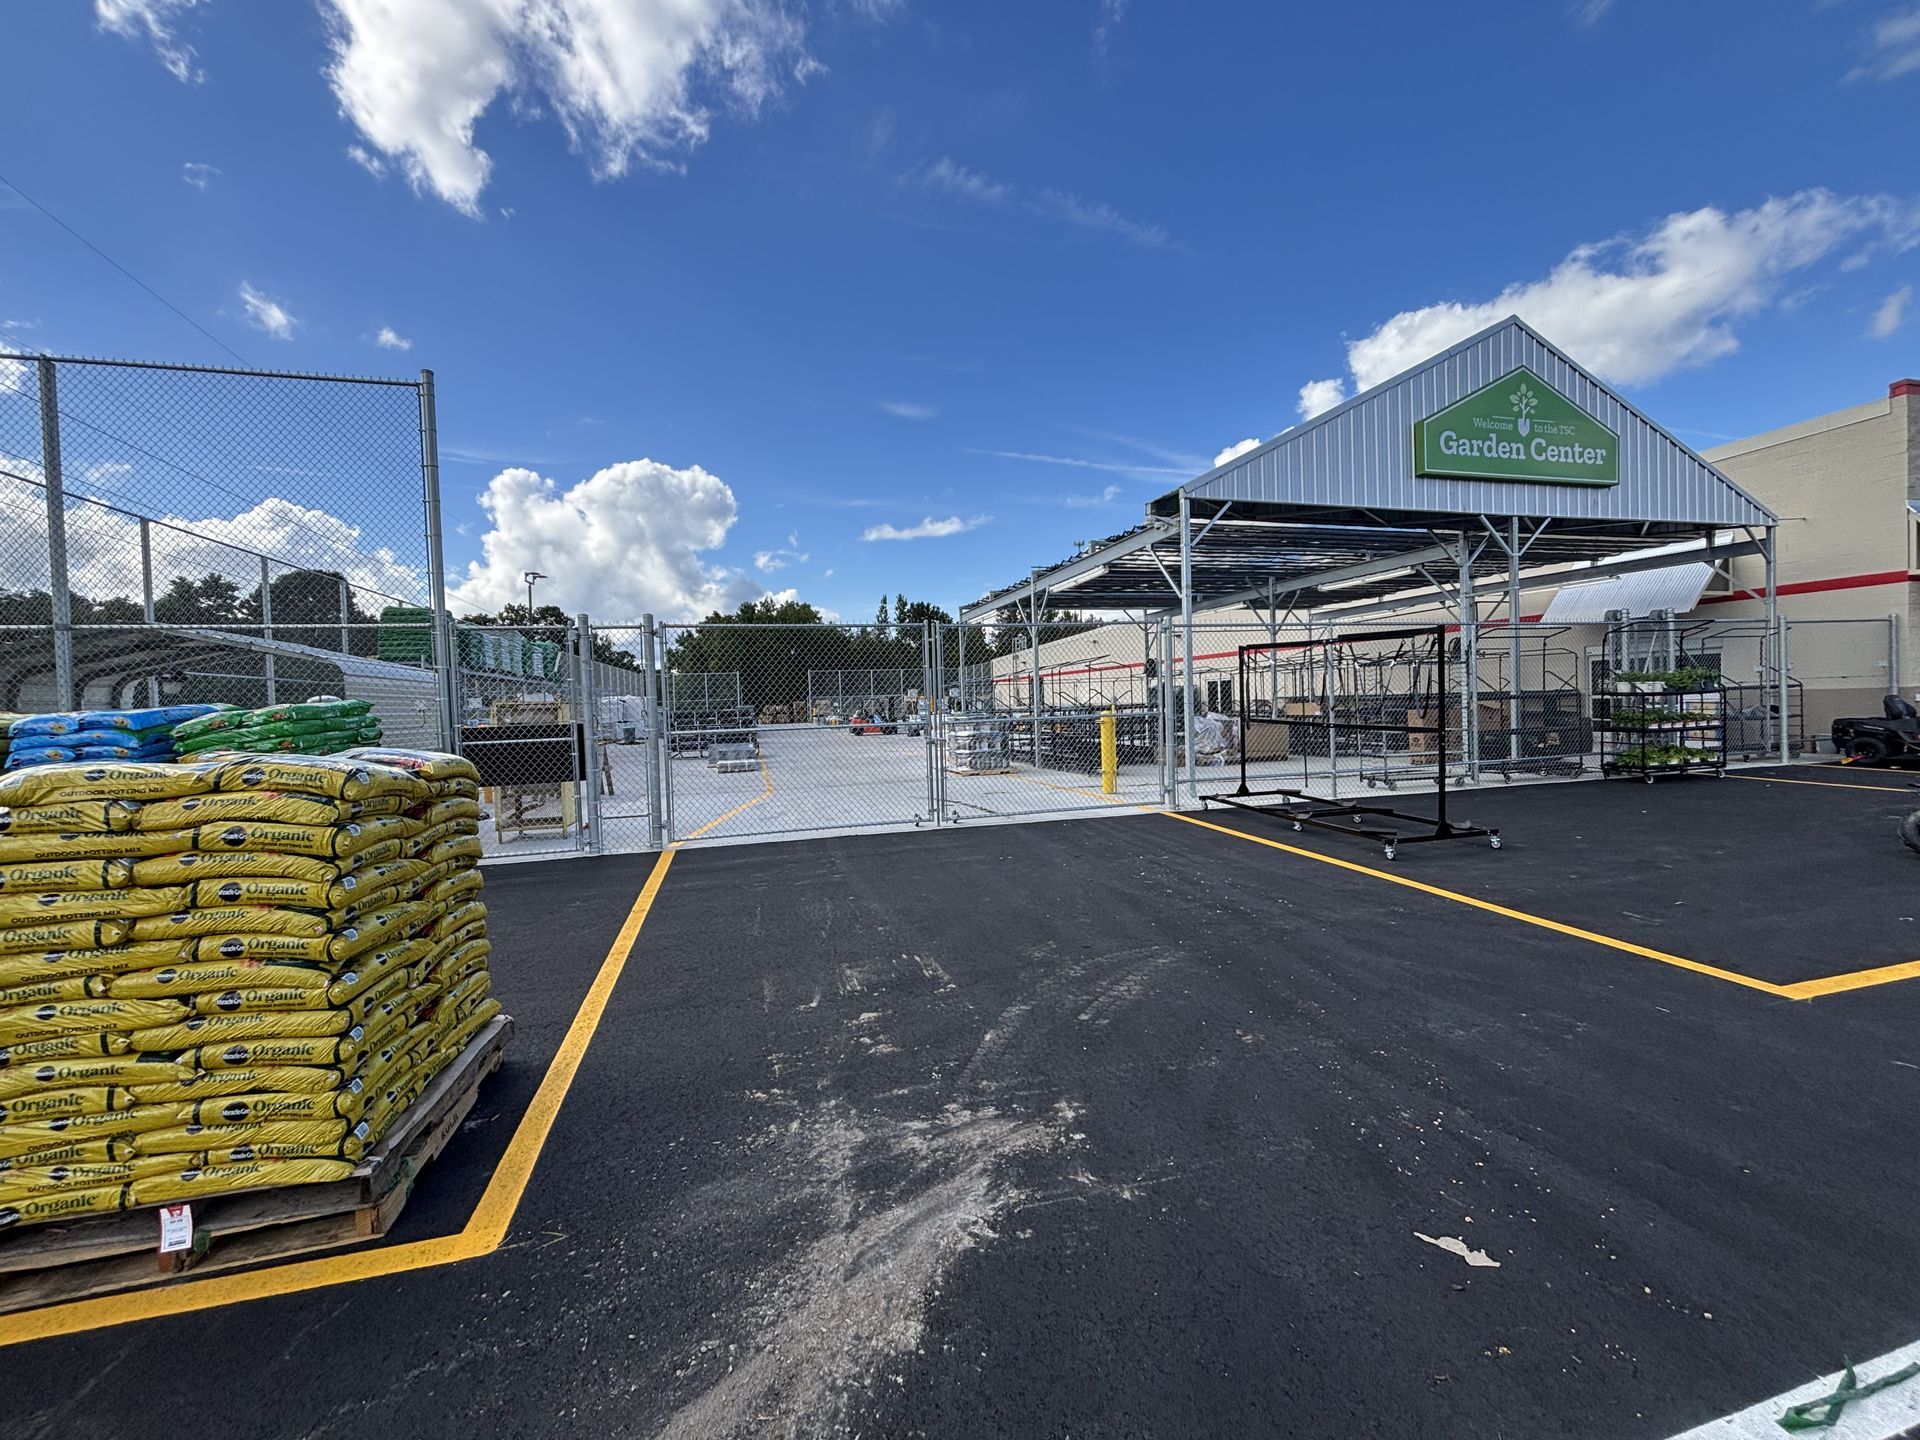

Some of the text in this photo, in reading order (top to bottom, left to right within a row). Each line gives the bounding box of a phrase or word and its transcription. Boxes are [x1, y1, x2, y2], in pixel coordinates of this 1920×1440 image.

[1473, 417, 1576, 436] Welcome to the TSC
[1439, 430, 1607, 465] Garden Center
[268, 768, 327, 784] Organic
[60, 789, 105, 797] OUTDOOR
[17, 807, 82, 821] Organic
[251, 828, 315, 842] Organic
[365, 843, 392, 861] Organic
[10, 866, 80, 882] Organic
[62, 890, 129, 903] Organic
[246, 882, 308, 896] Organic
[358, 890, 388, 911] Organic
[60, 912, 102, 920] POTTING
[192, 908, 249, 920] Organic
[3, 926, 72, 943] Organic
[248, 937, 309, 950] Organic
[21, 972, 68, 981] OUTDOOR
[70, 967, 110, 975] POTTING
[179, 967, 238, 981] Organic
[245, 988, 306, 1003] Organic
[374, 976, 401, 1000] Organic
[60, 1002, 126, 1017] Organic
[207, 1013, 267, 1027] Organic
[16, 1029, 59, 1038] OUTDOOR
[370, 1024, 398, 1052] Organic
[14, 1037, 79, 1055] Organic
[252, 1043, 315, 1058] Organic
[58, 1065, 126, 1079] Organic
[376, 1066, 402, 1097] Organic
[12, 1093, 86, 1112] Organic
[253, 1099, 315, 1112] Organic
[72, 1109, 139, 1127] Organic
[257, 1144, 317, 1155] Organic
[202, 1162, 264, 1178] Organic
[25, 1194, 98, 1215] Organic
